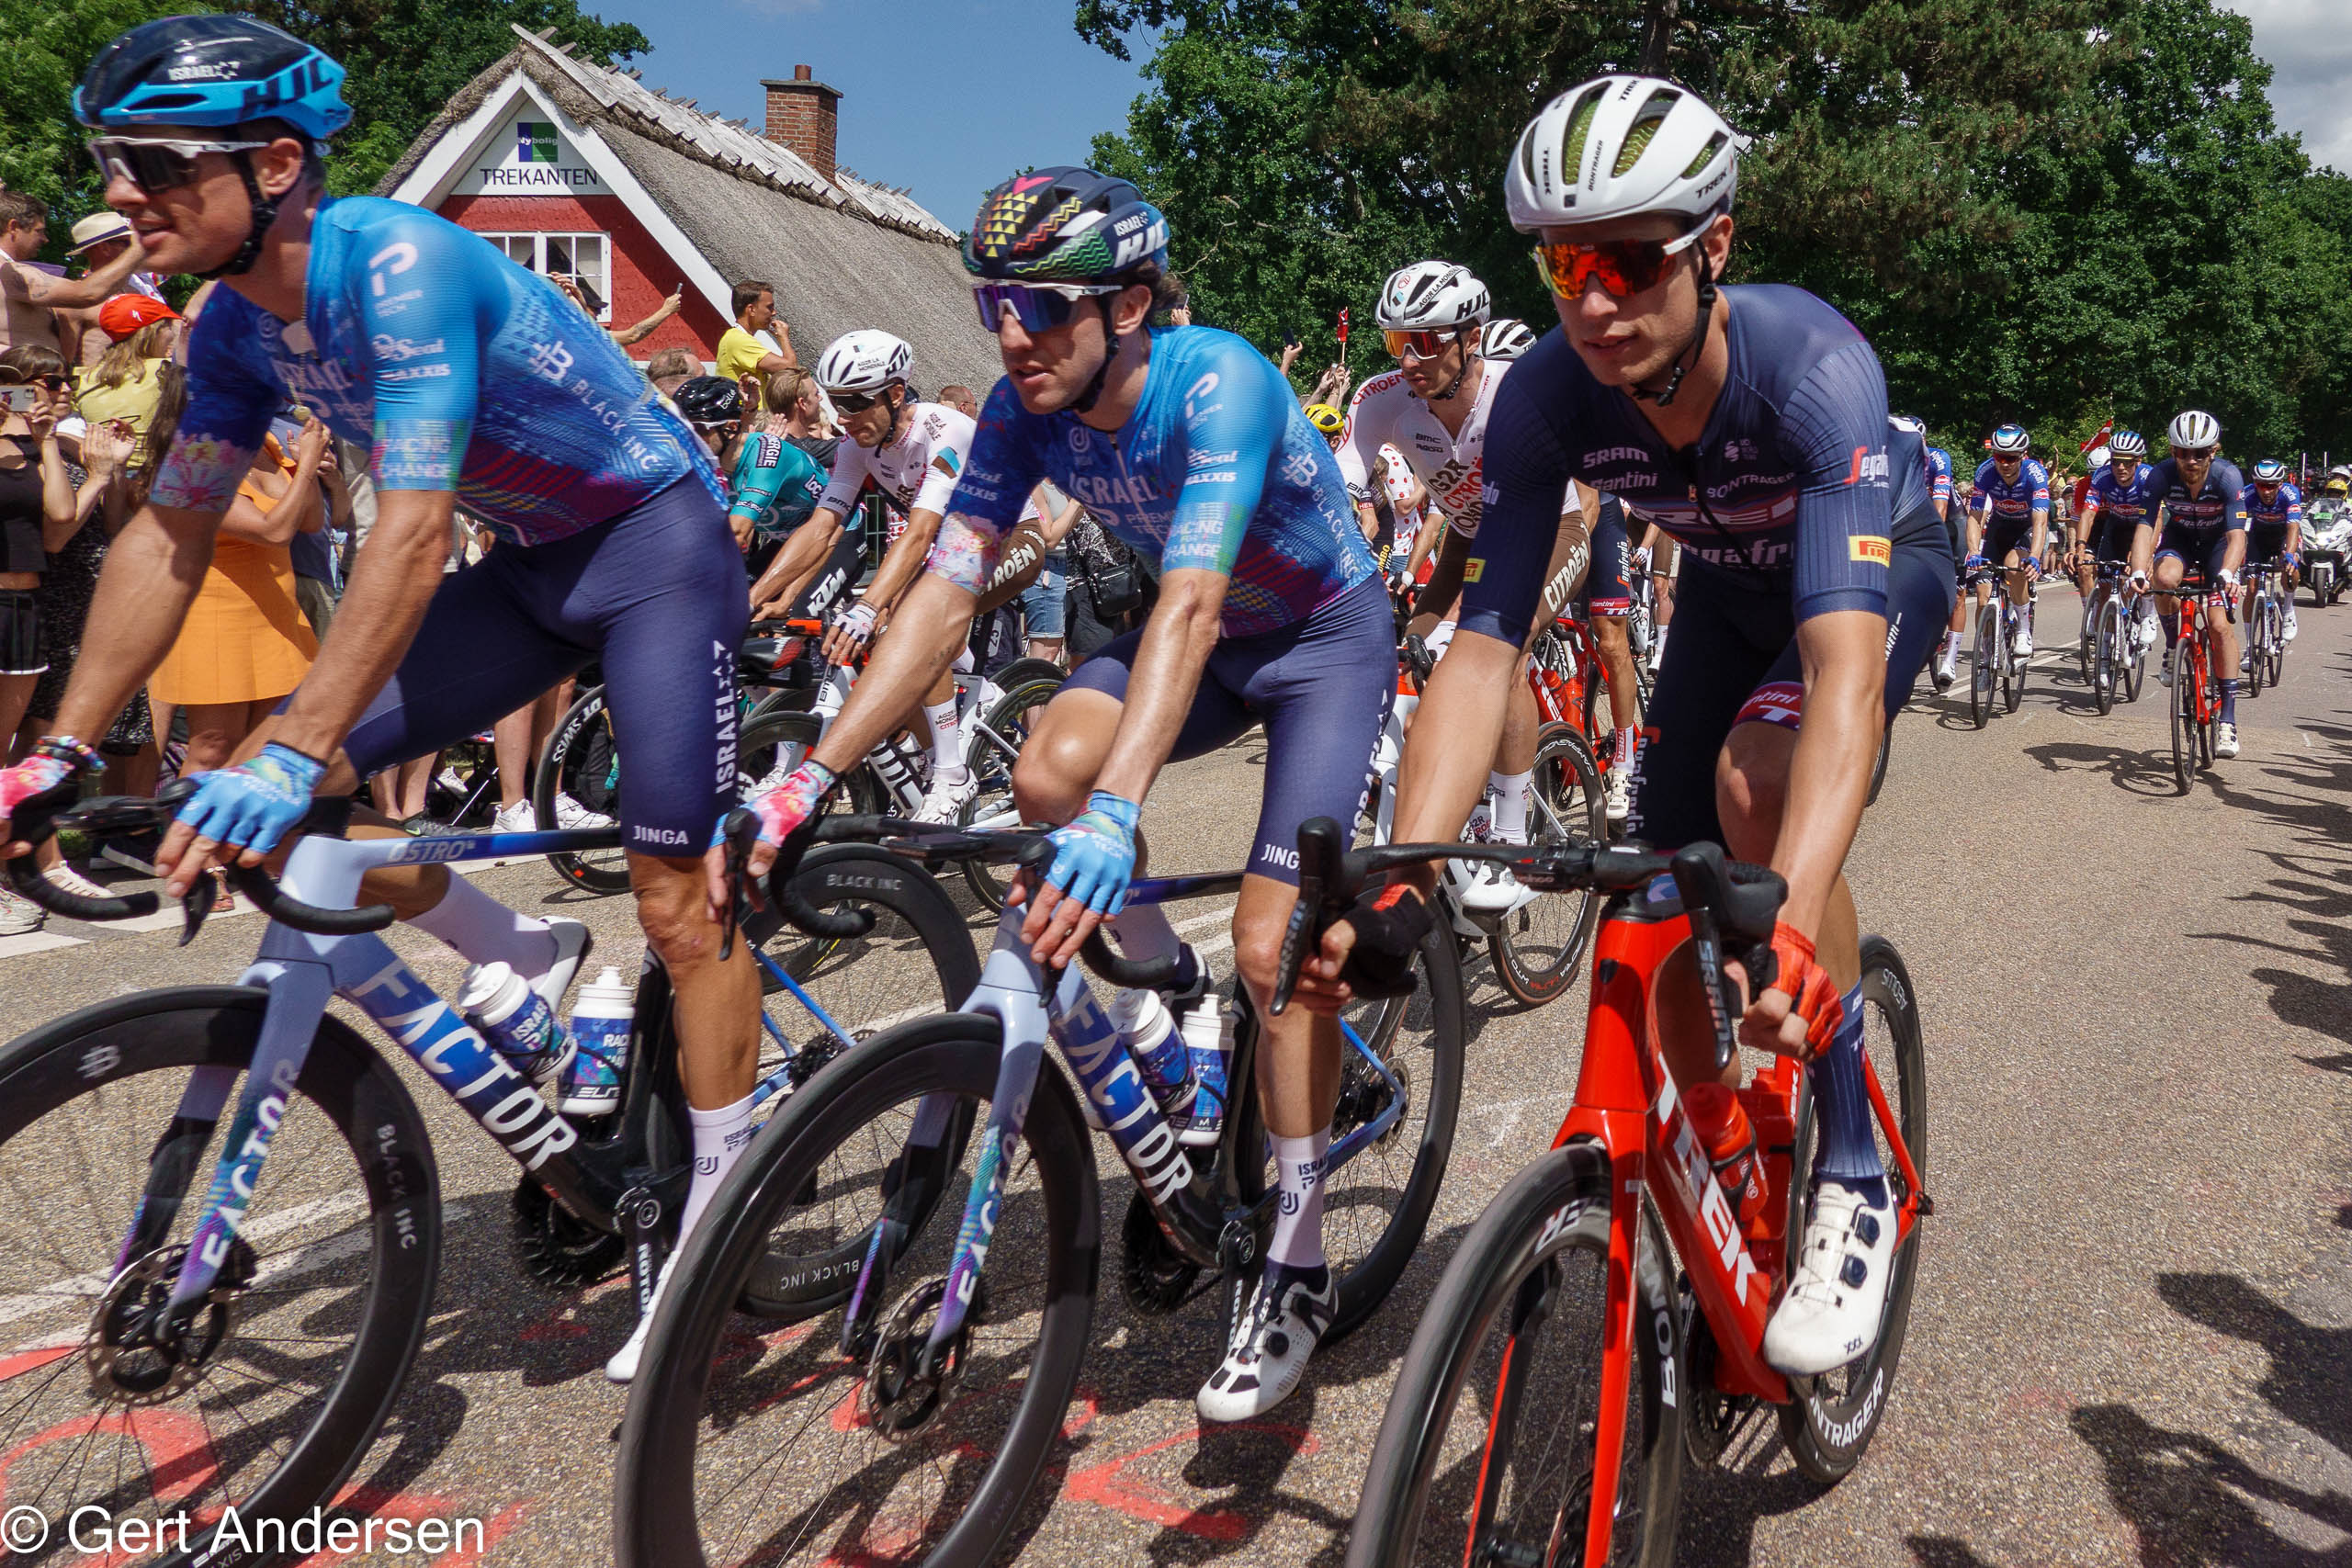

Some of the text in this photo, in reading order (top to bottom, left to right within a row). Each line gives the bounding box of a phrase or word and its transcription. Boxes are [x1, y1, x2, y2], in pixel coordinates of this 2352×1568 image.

[480, 168, 598, 186] TREKANTEN
[1588, 140, 1604, 191] BONTRAGER
[1113, 219, 1170, 268] HJC
[1455, 288, 1489, 321] HJC
[571, 378, 660, 470] BLACK INC
[1583, 446, 1650, 469] SRAM
[1069, 471, 1159, 504] ISRAEL
[987, 544, 1037, 592] ROËN
[1544, 540, 1590, 613] CITROËN
[807, 567, 847, 617] KTM
[1603, 607, 1628, 615] TR
[552, 717, 582, 764] SWISS
[715, 688, 737, 794] ISRAEL
[940, 719, 958, 730] CITRO
[632, 825, 689, 845] JINGA
[1261, 842, 1300, 871] JING
[827, 874, 902, 891] BLACK INC
[1697, 940, 1733, 1043] SRAM
[510, 999, 549, 1042] ISRAE
[351, 958, 578, 1172] FACTOR
[1058, 990, 1193, 1206] FACTOR
[1297, 1156, 1329, 1177] ISRA
[1657, 1050, 1758, 1307] TREK
[394, 1207, 418, 1250] INC
[780, 1258, 861, 1289] BLACK INC
[1808, 1366, 1883, 1448] NTRAGER
